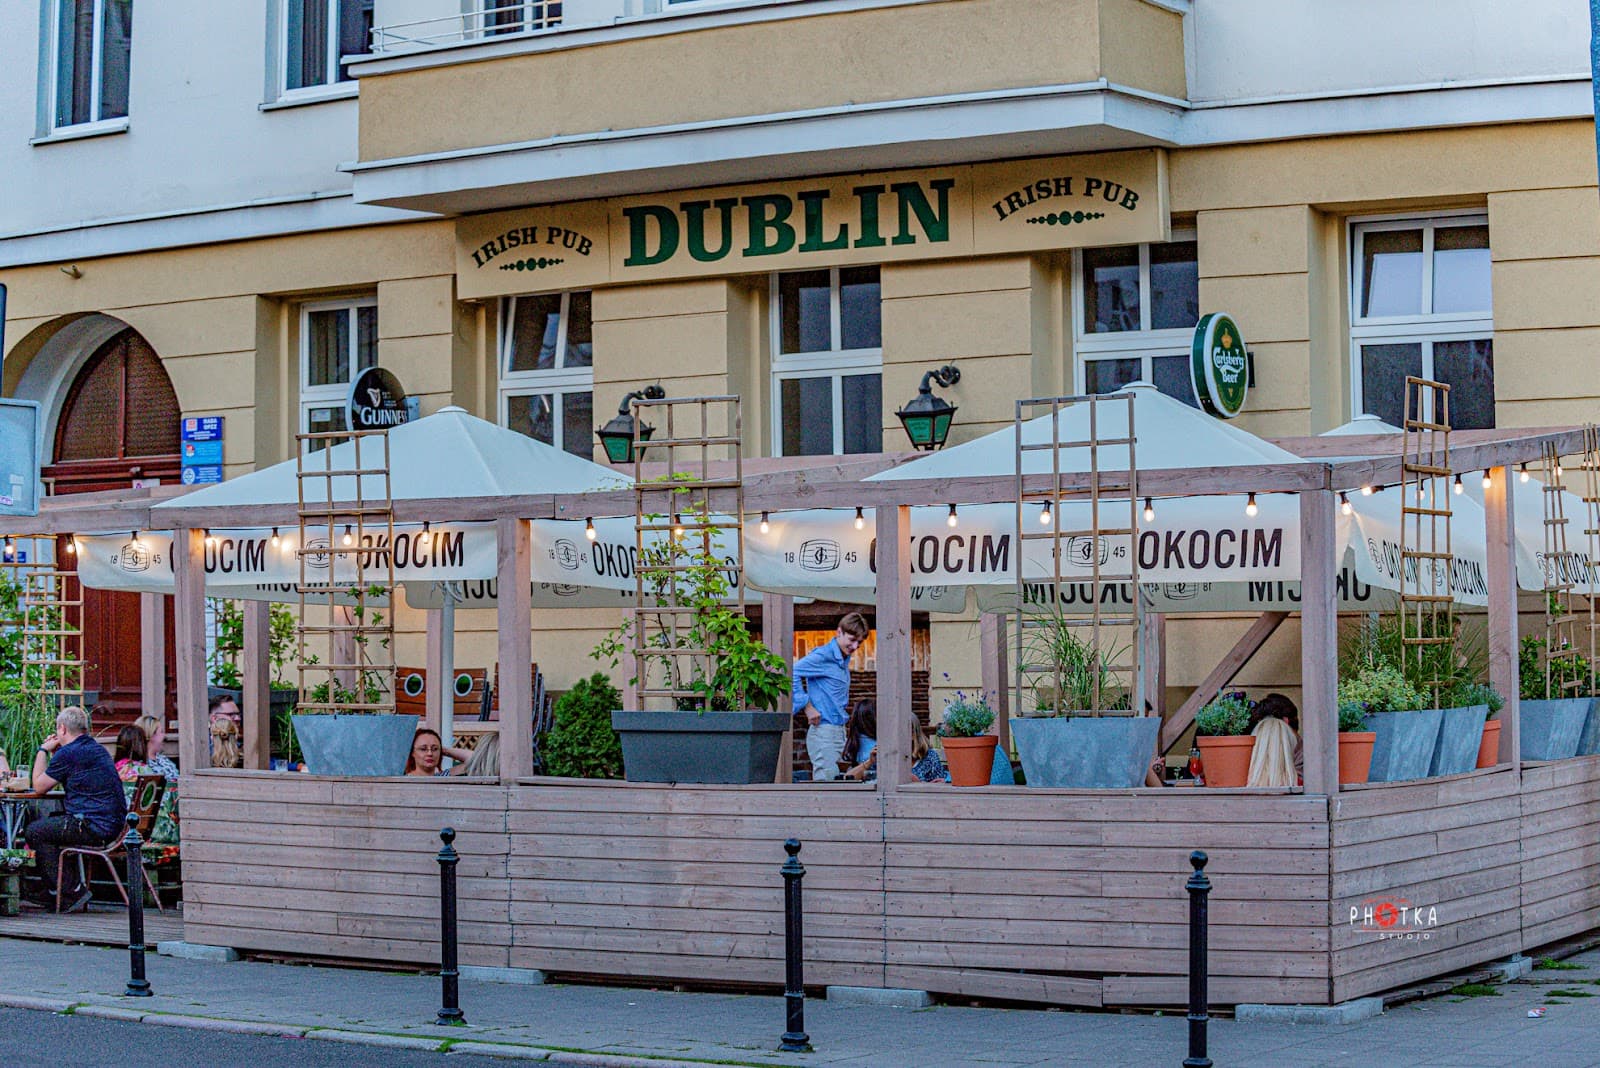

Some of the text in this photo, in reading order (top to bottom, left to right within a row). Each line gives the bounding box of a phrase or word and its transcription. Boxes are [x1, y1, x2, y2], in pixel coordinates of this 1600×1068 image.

[992, 177, 1140, 221] IRISH PUB
[624, 179, 955, 267] DUBLIN
[472, 226, 593, 268] IRISH PUB
[1213, 346, 1245, 372] Carlsberg
[1222, 372, 1238, 383] Beer
[153, 554, 162, 564] 45
[169, 539, 267, 573] OCIM
[356, 531, 464, 569] OKOCIM
[784, 552, 795, 563] 18
[844, 552, 857, 563] 45
[1112, 546, 1126, 558] 45
[1138, 528, 1282, 569] OKOCIM
